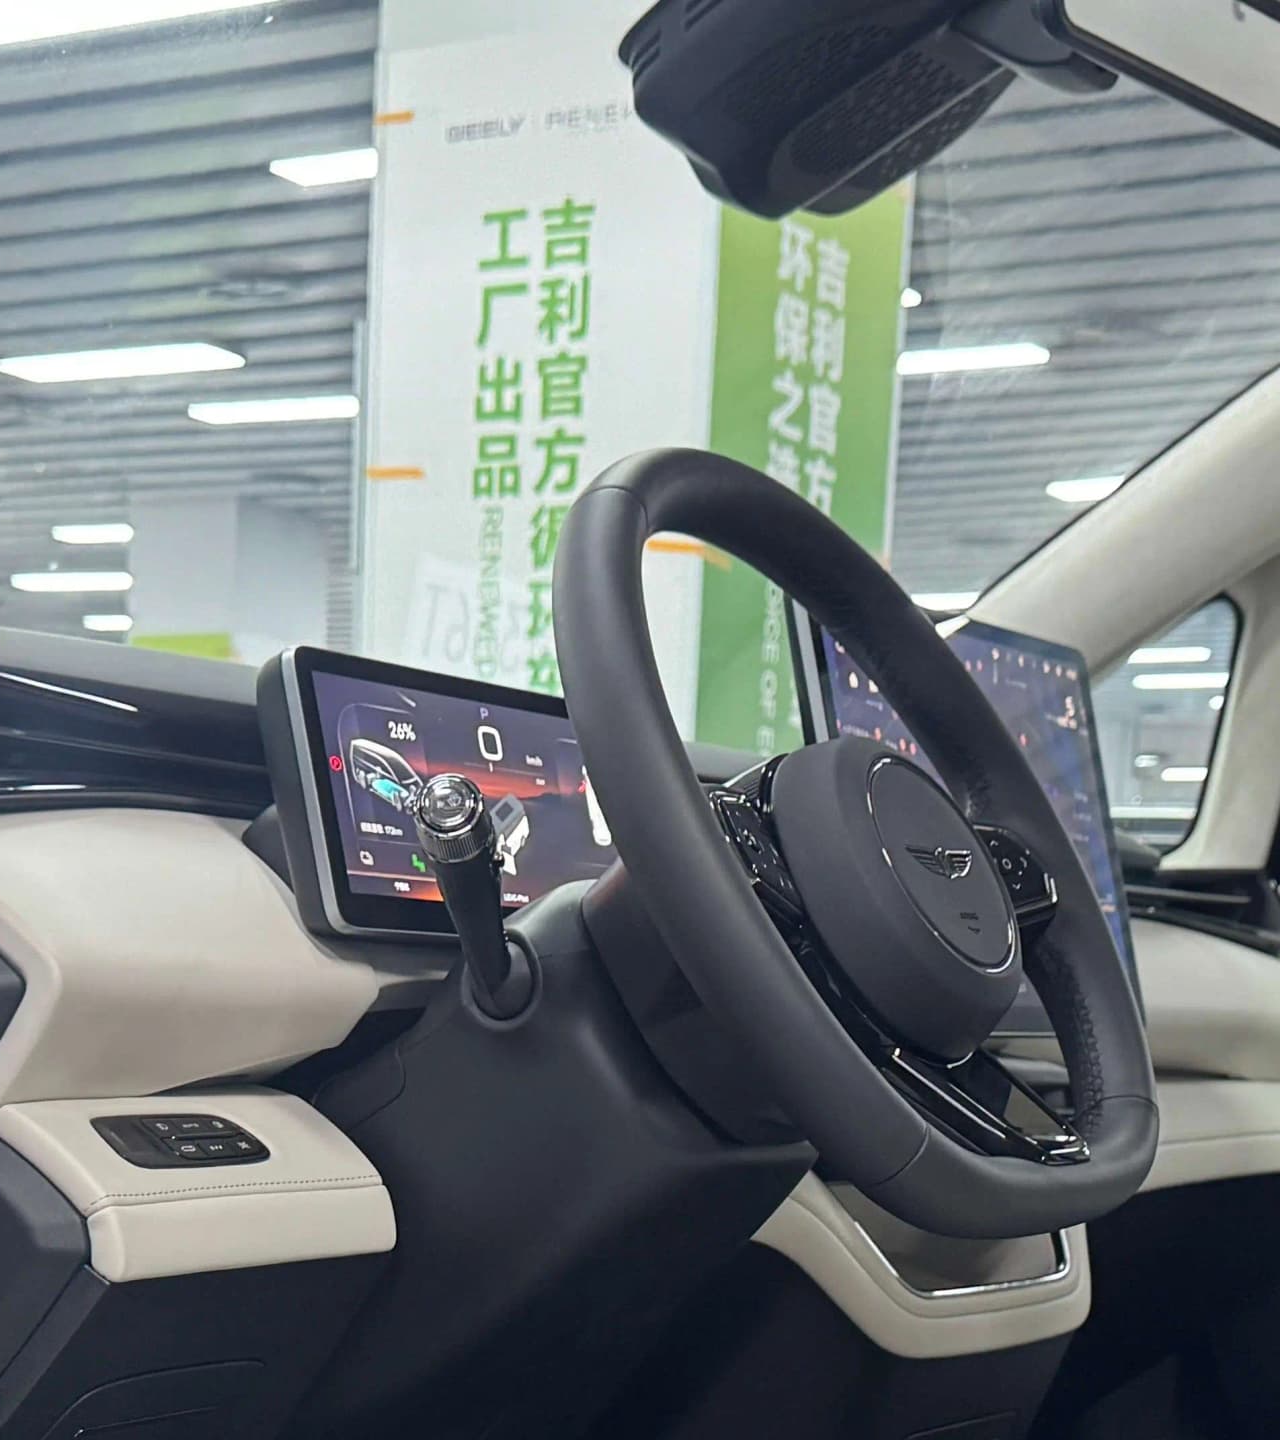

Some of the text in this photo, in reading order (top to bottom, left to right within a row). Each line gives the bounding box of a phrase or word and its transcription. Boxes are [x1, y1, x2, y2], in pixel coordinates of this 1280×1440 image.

[473, 208, 530, 499] 工厂出品
[480, 706, 489, 720] P
[388, 721, 417, 742] 26%
[477, 725, 504, 762] 0
